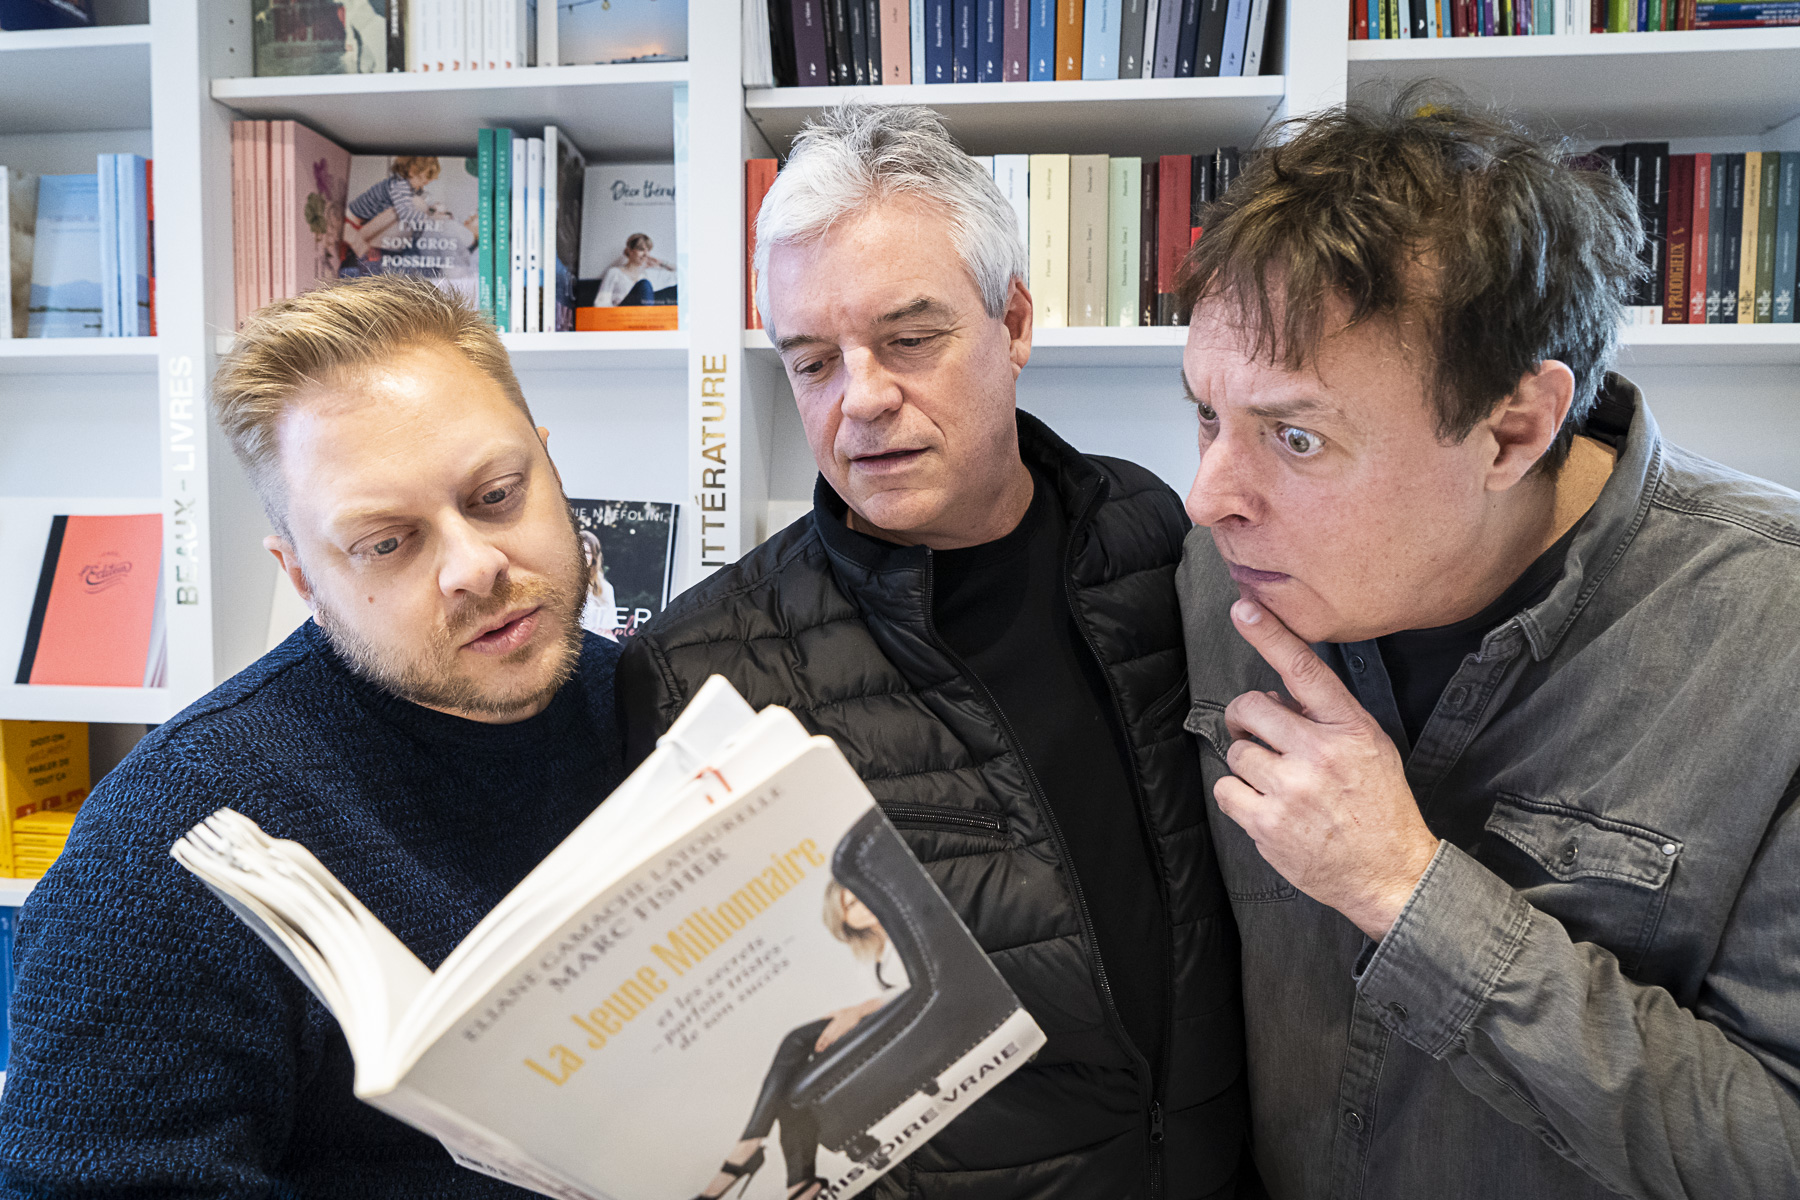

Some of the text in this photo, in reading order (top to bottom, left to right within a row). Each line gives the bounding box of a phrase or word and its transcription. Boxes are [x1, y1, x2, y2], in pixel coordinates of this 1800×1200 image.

[381, 237, 458, 251] SON GROS
[381, 254, 455, 269] POSSIBLE
[1668, 243, 1685, 308] PRODIGIEUX
[167, 355, 196, 472] LIVRES
[694, 353, 727, 567] ITTÉRATURE
[173, 497, 199, 607] BEAUX
[539, 880, 646, 971] GAMACHE
[650, 786, 782, 882] LATOURELLE
[548, 847, 729, 993] MARC FISHER
[523, 837, 826, 1087] La Jeune Millionnaire
[656, 936, 765, 1028] et les secrets
[664, 945, 781, 1045] parfois tristes
[679, 1029, 700, 1050] de
[703, 1002, 735, 1030] son
[818, 1041, 1020, 1200] HISTOIRE VRAIE
